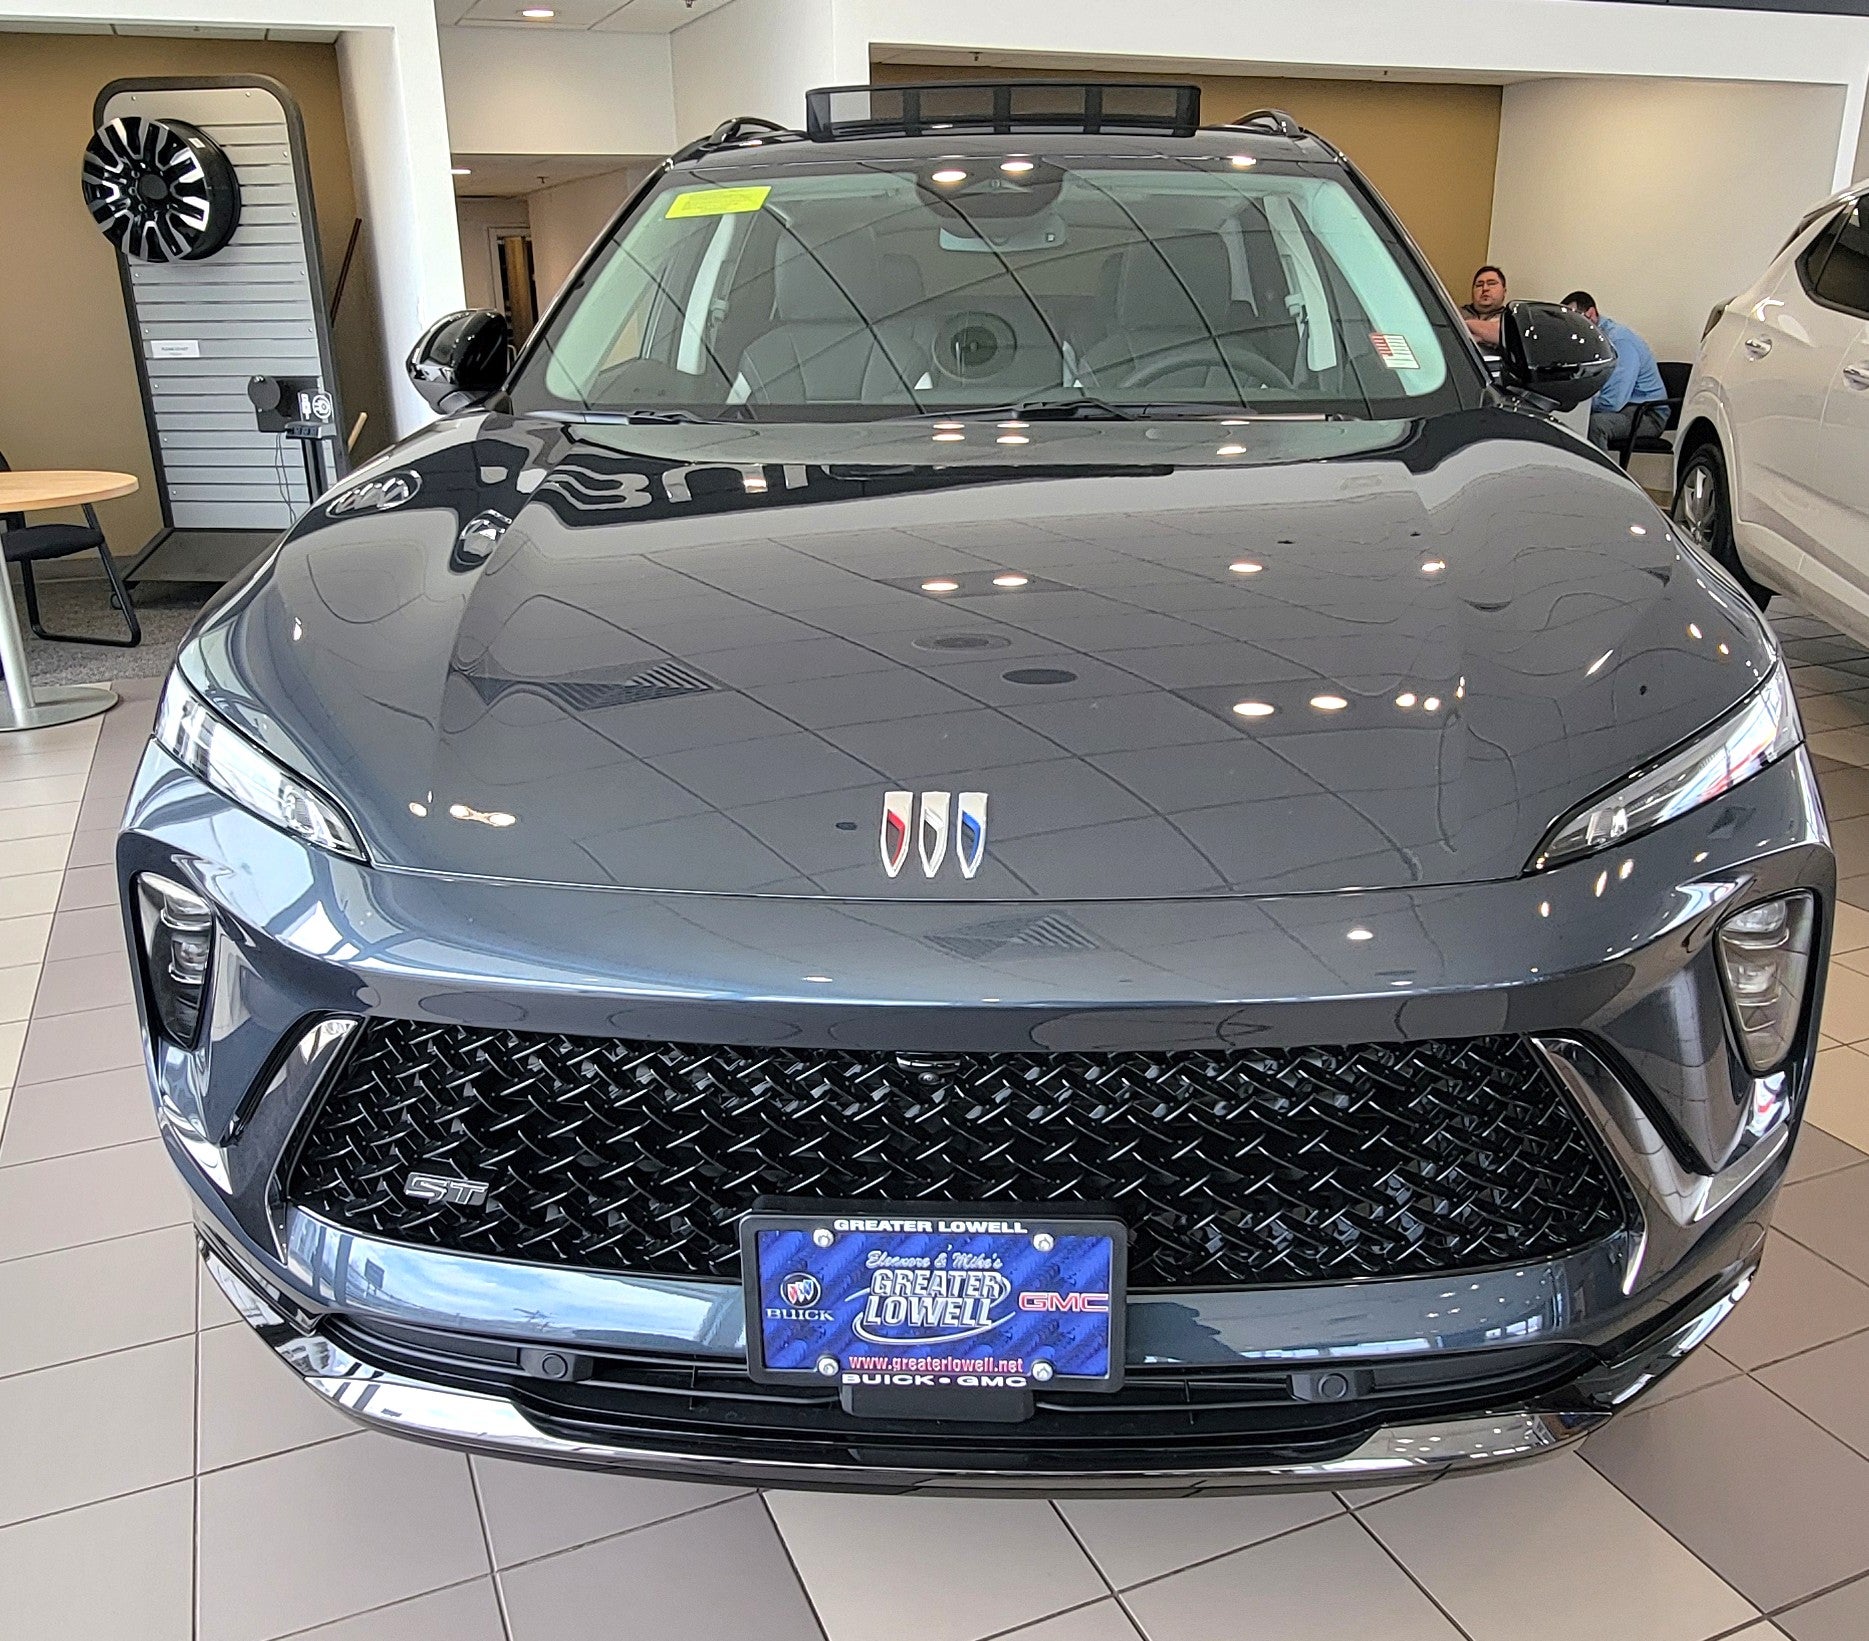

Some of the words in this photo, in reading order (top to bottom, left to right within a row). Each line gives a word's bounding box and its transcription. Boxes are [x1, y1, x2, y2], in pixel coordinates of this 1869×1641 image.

[404, 1174, 487, 1206] ST
[833, 1218, 934, 1234] GREATER
[938, 1220, 1029, 1235] LOWELL
[933, 1252, 948, 1269] &
[952, 1252, 1004, 1270] Mike's
[870, 1269, 1002, 1299] GREATER
[1018, 1291, 1109, 1313] GMC
[765, 1308, 835, 1321] BUICK
[863, 1295, 993, 1328] LOWELL
[848, 1355, 1024, 1373] www.greaterlowell.net
[841, 1373, 935, 1386] BUICK
[956, 1375, 1028, 1387] GMC
